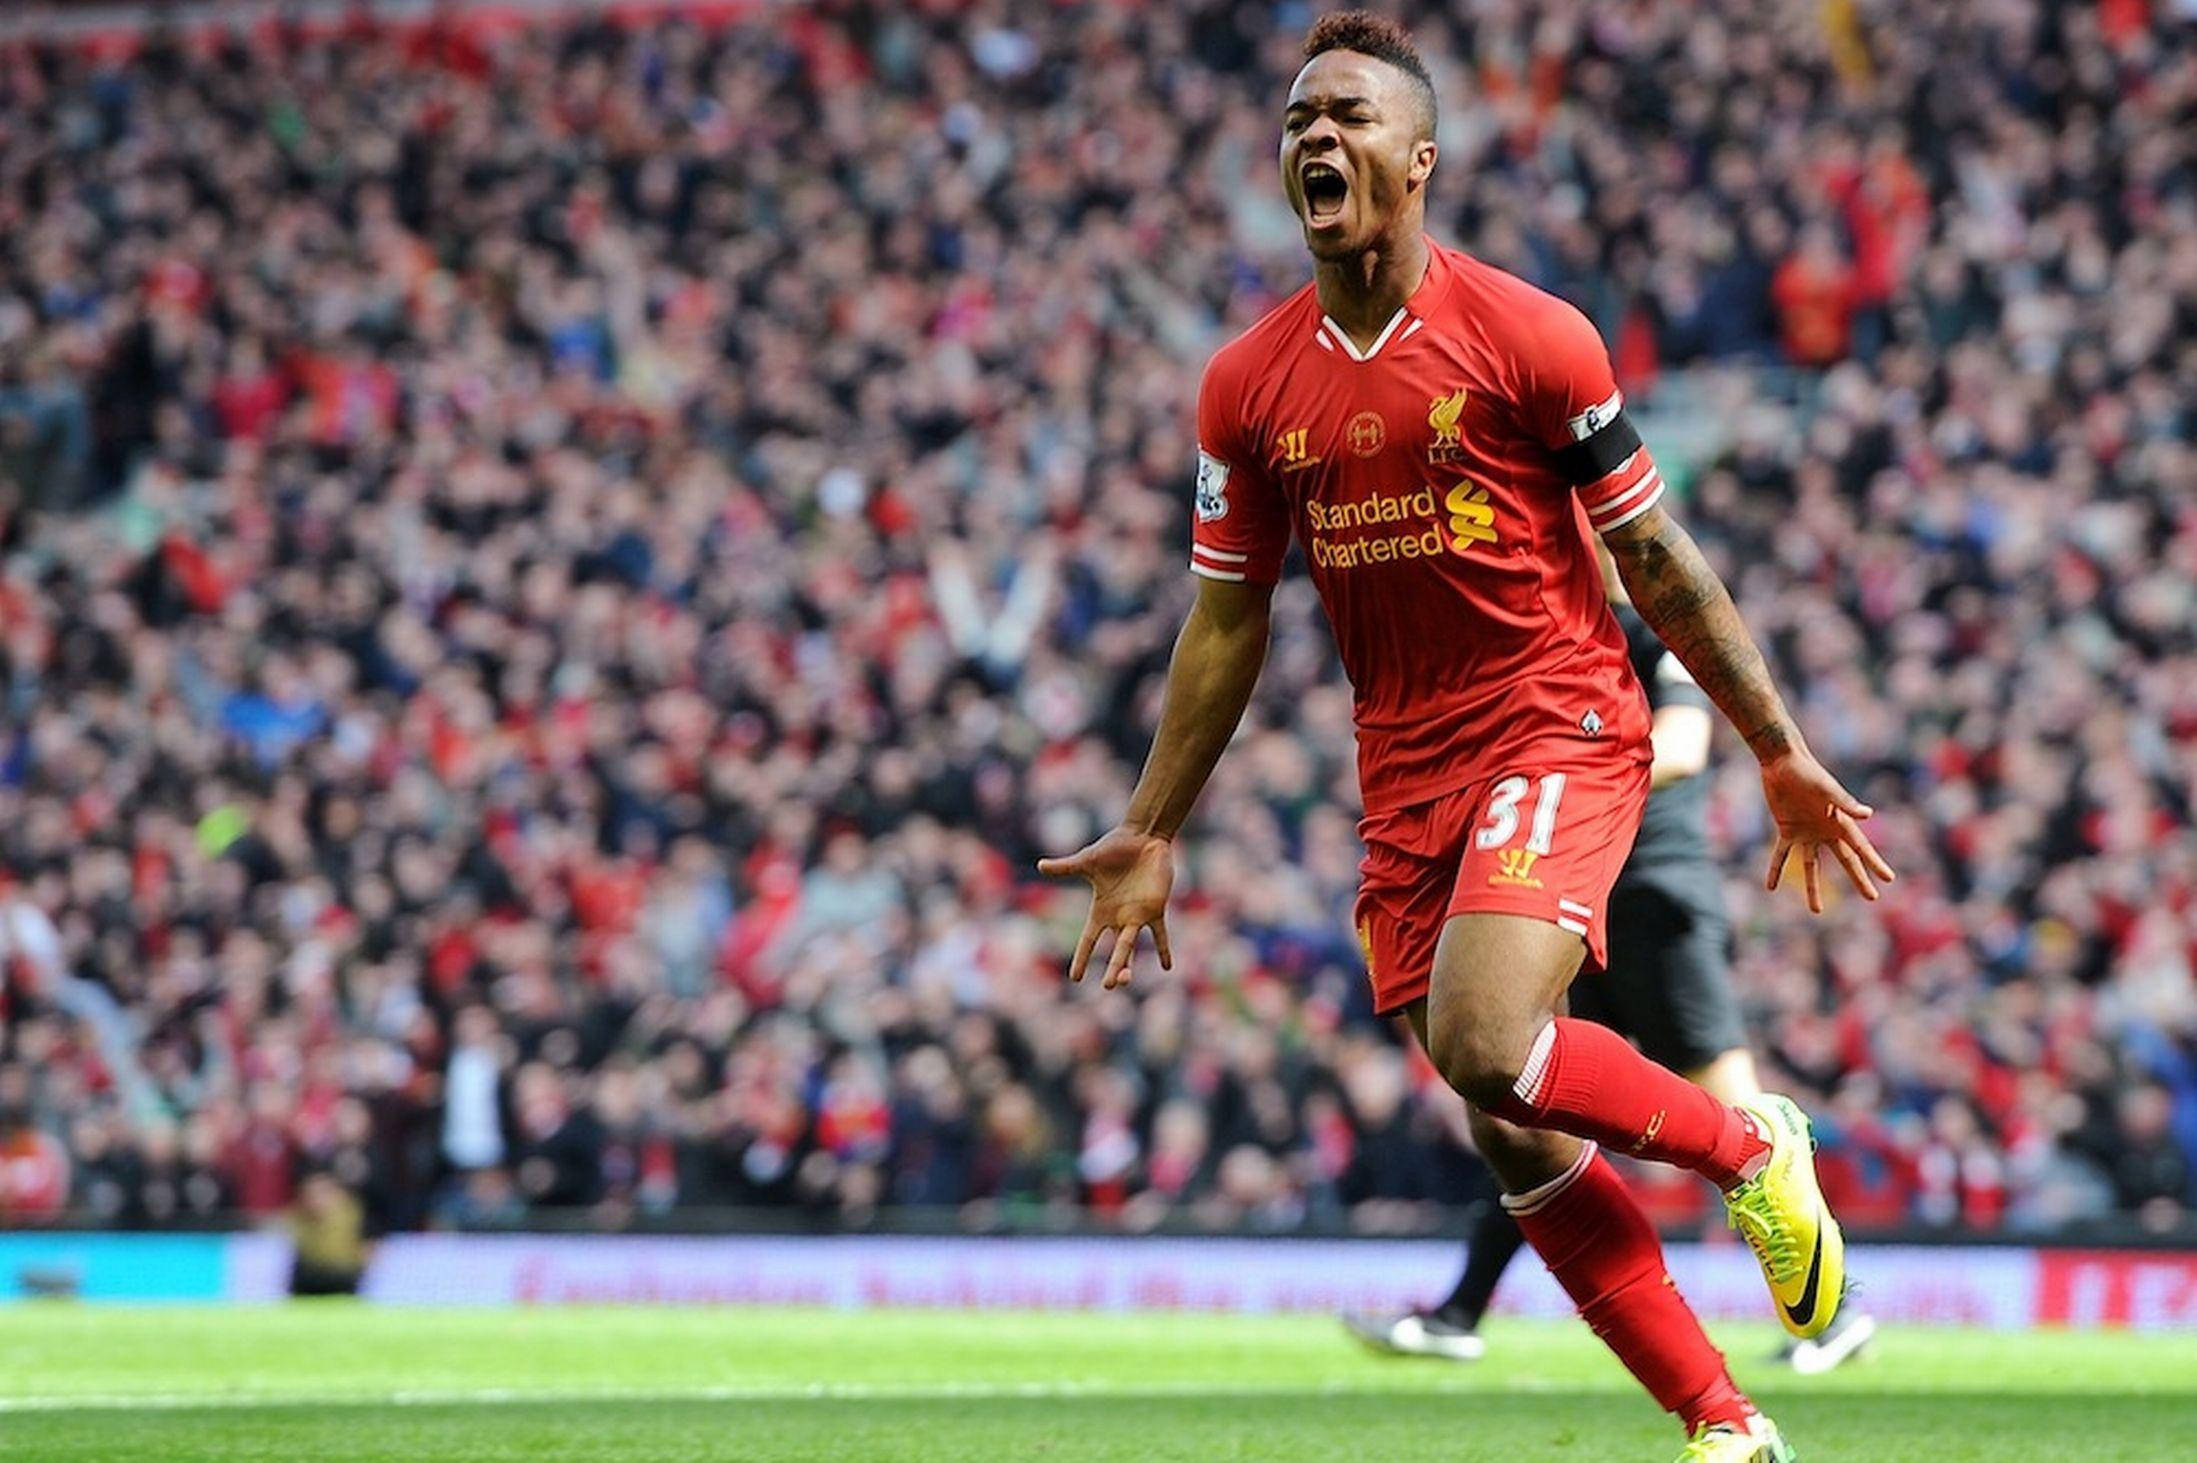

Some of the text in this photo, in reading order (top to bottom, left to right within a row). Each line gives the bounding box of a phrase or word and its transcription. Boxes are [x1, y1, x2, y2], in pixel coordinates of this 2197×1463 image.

[1306, 485, 1436, 531] Standard
[1312, 522, 1443, 568] Chartered
[1475, 772, 1567, 855] 31
